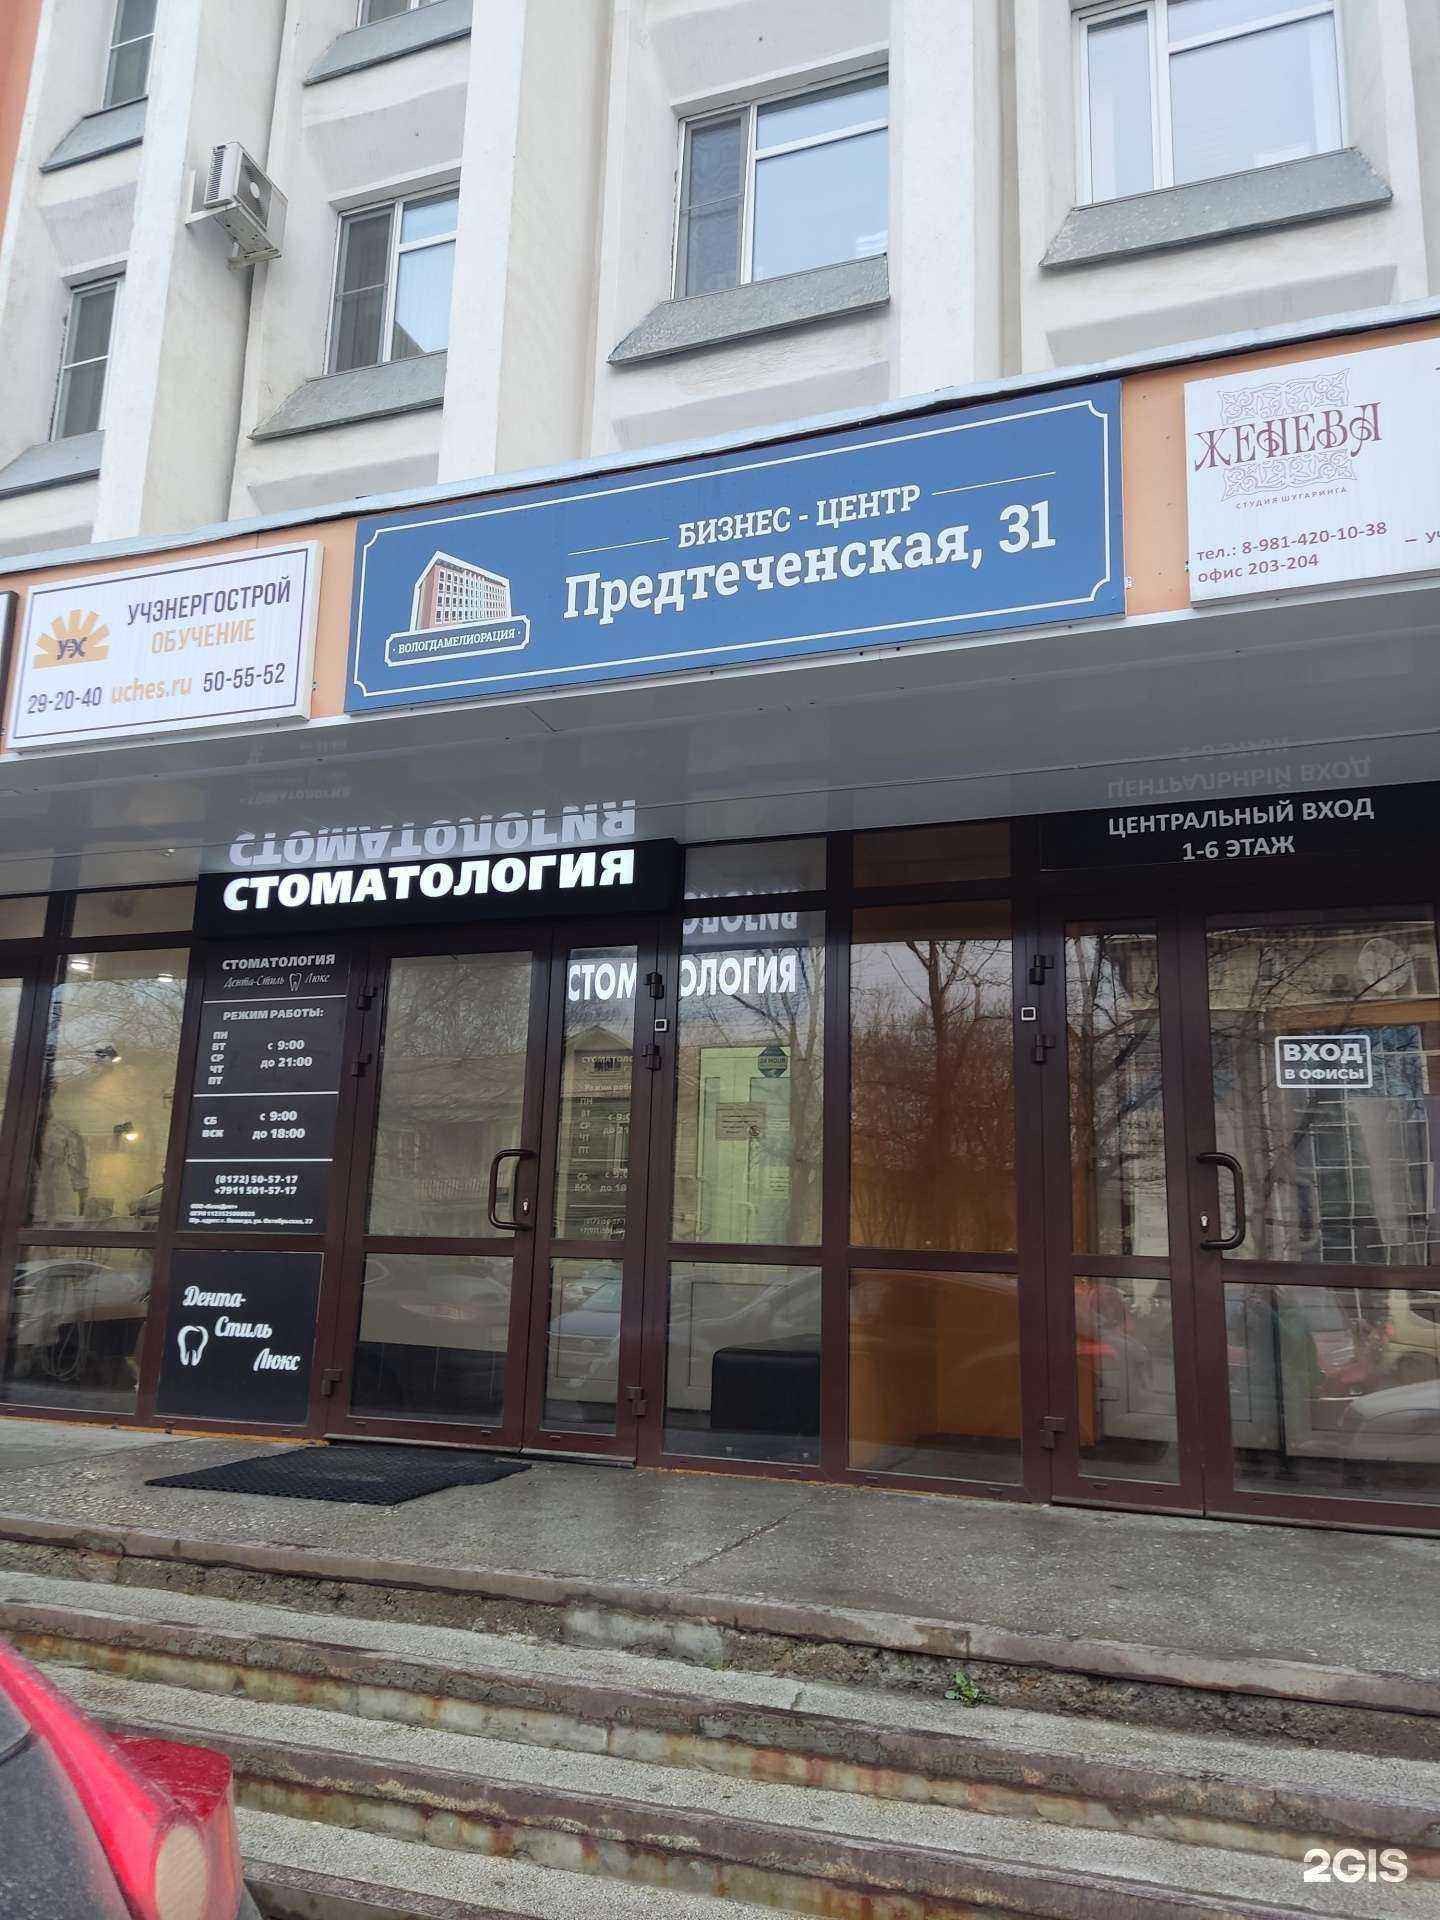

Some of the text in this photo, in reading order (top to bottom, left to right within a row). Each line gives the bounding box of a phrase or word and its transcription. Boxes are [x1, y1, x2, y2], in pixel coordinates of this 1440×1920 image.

[678, 506, 792, 550] БИЗНЕС
[815, 483, 921, 528] ЦЕНТР
[1197, 521, 1388, 561] тел.: 8-981-420-10-38
[562, 500, 1056, 626] Предтеченская, 31
[1198, 553, 1320, 583] офис 203-204
[128, 576, 291, 626] УЧЭНЕРГОСТРОЙ
[151, 618, 256, 655] ОБУЧЕНИЕ
[398, 628, 516, 655] ВОЛОГДАМЕЛИОРАЦИЯ
[27, 662, 286, 715] 29-20-40 uches.ru 50-55-52
[1108, 798, 1375, 838] ЦЕНТРАЛЬНЫЙ ВХОД
[1182, 835, 1296, 860] 1-6 ЭТАЖ
[223, 849, 635, 912] СТОМАТОЛОГИЯ
[222, 954, 336, 970] СТОМАТОЛОГИЯ
[305, 972, 330, 983] Люкс
[223, 1008, 324, 1021] РЕЖИМ РАБОТЫ:
[213, 1031, 228, 1040] ПН
[212, 1043, 226, 1051] ВТ
[277, 1039, 305, 1050] 9:00
[210, 1054, 225, 1063] СР
[1283, 1044, 1363, 1063] ВХОД
[210, 1065, 224, 1074] ЧТ
[260, 1057, 313, 1069] до 21:00
[208, 1077, 223, 1085] ПТ
[1285, 1069, 1365, 1079] В ОФИСЫ
[203, 1117, 217, 1125] СБ
[260, 1110, 298, 1122] с 9:00
[202, 1129, 224, 1138] ВСК
[252, 1127, 306, 1140] до 18:00
[251, 1175, 298, 1184] 50-57-17
[214, 1187, 297, 1195] +7911 501-57-17
[182, 1285, 247, 1308] Дента-
[214, 1316, 273, 1339] Стиль
[253, 1348, 301, 1371] Люкс
